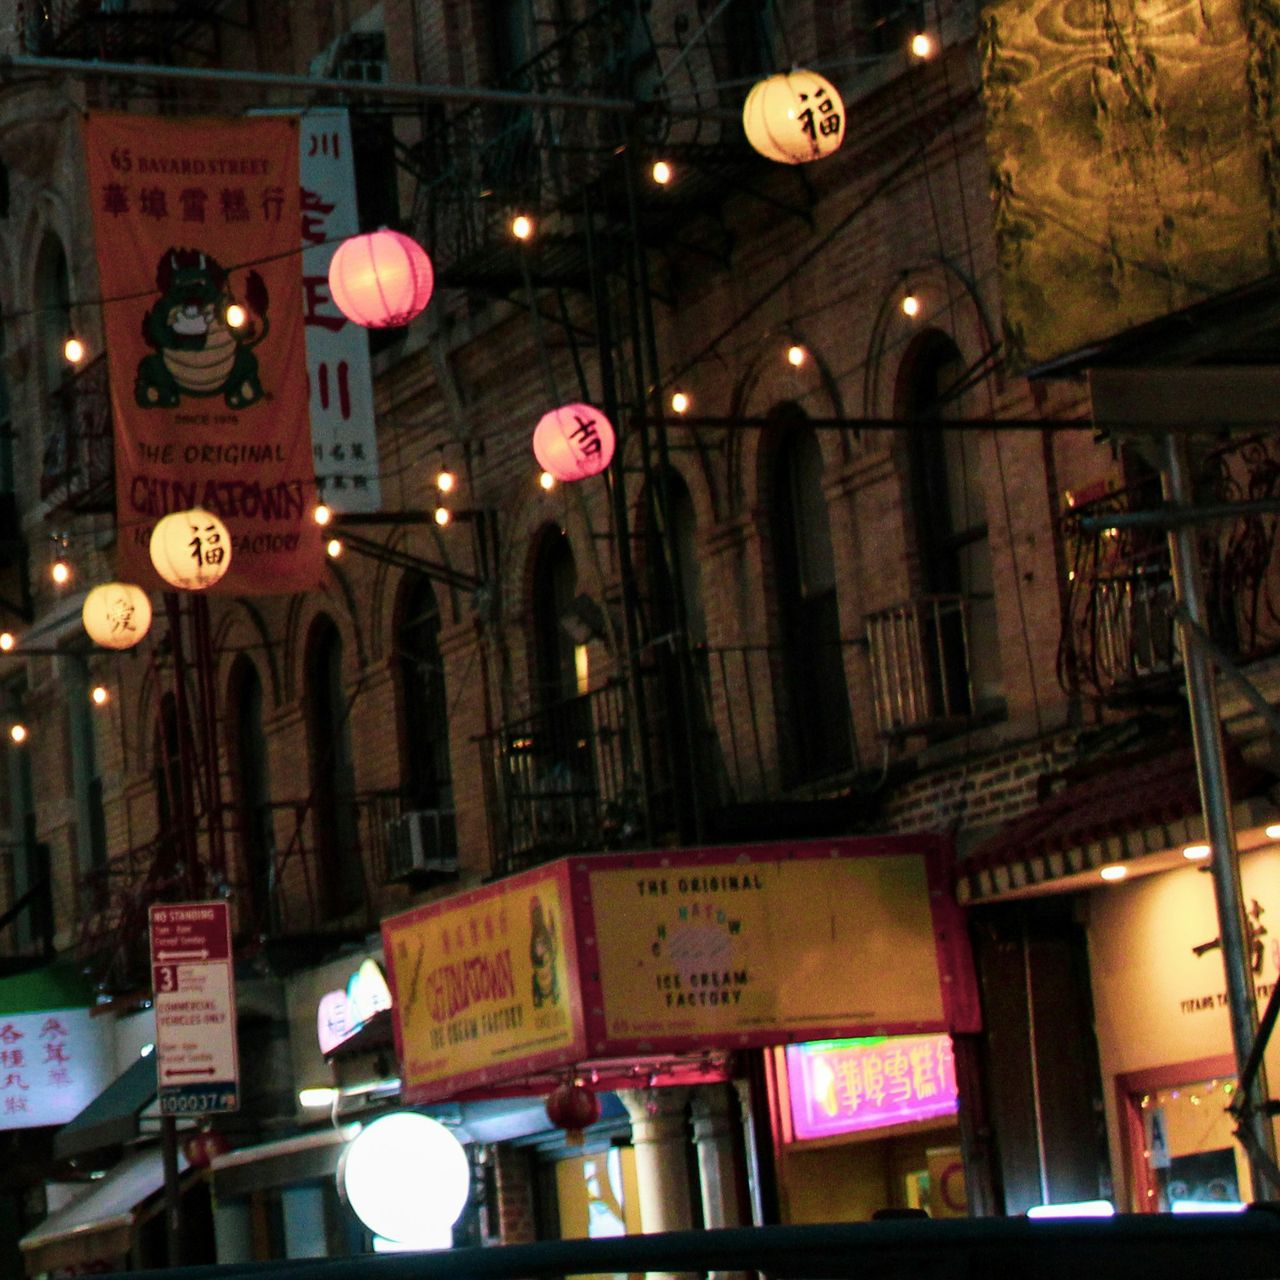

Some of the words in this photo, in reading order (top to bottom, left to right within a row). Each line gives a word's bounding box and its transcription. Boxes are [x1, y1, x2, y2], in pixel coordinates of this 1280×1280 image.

[798, 88, 840, 140] 福
[111, 147, 132, 171] 65
[139, 158, 206, 174] BAYARD
[208, 157, 268, 175] STREET
[140, 443, 176, 464] THE
[184, 444, 286, 466] ORIGINAL
[131, 475, 305, 522] CHINATOWN
[189, 525, 224, 567] 福
[637, 878, 669, 896] THE
[678, 875, 763, 894] ORIGINAL
[154, 909, 167, 923] NO
[169, 908, 214, 922] STANDING
[160, 967, 173, 992] 3
[657, 975, 682, 993] ICE
[690, 971, 750, 990] CREAM
[665, 991, 743, 1010] FACTORY
